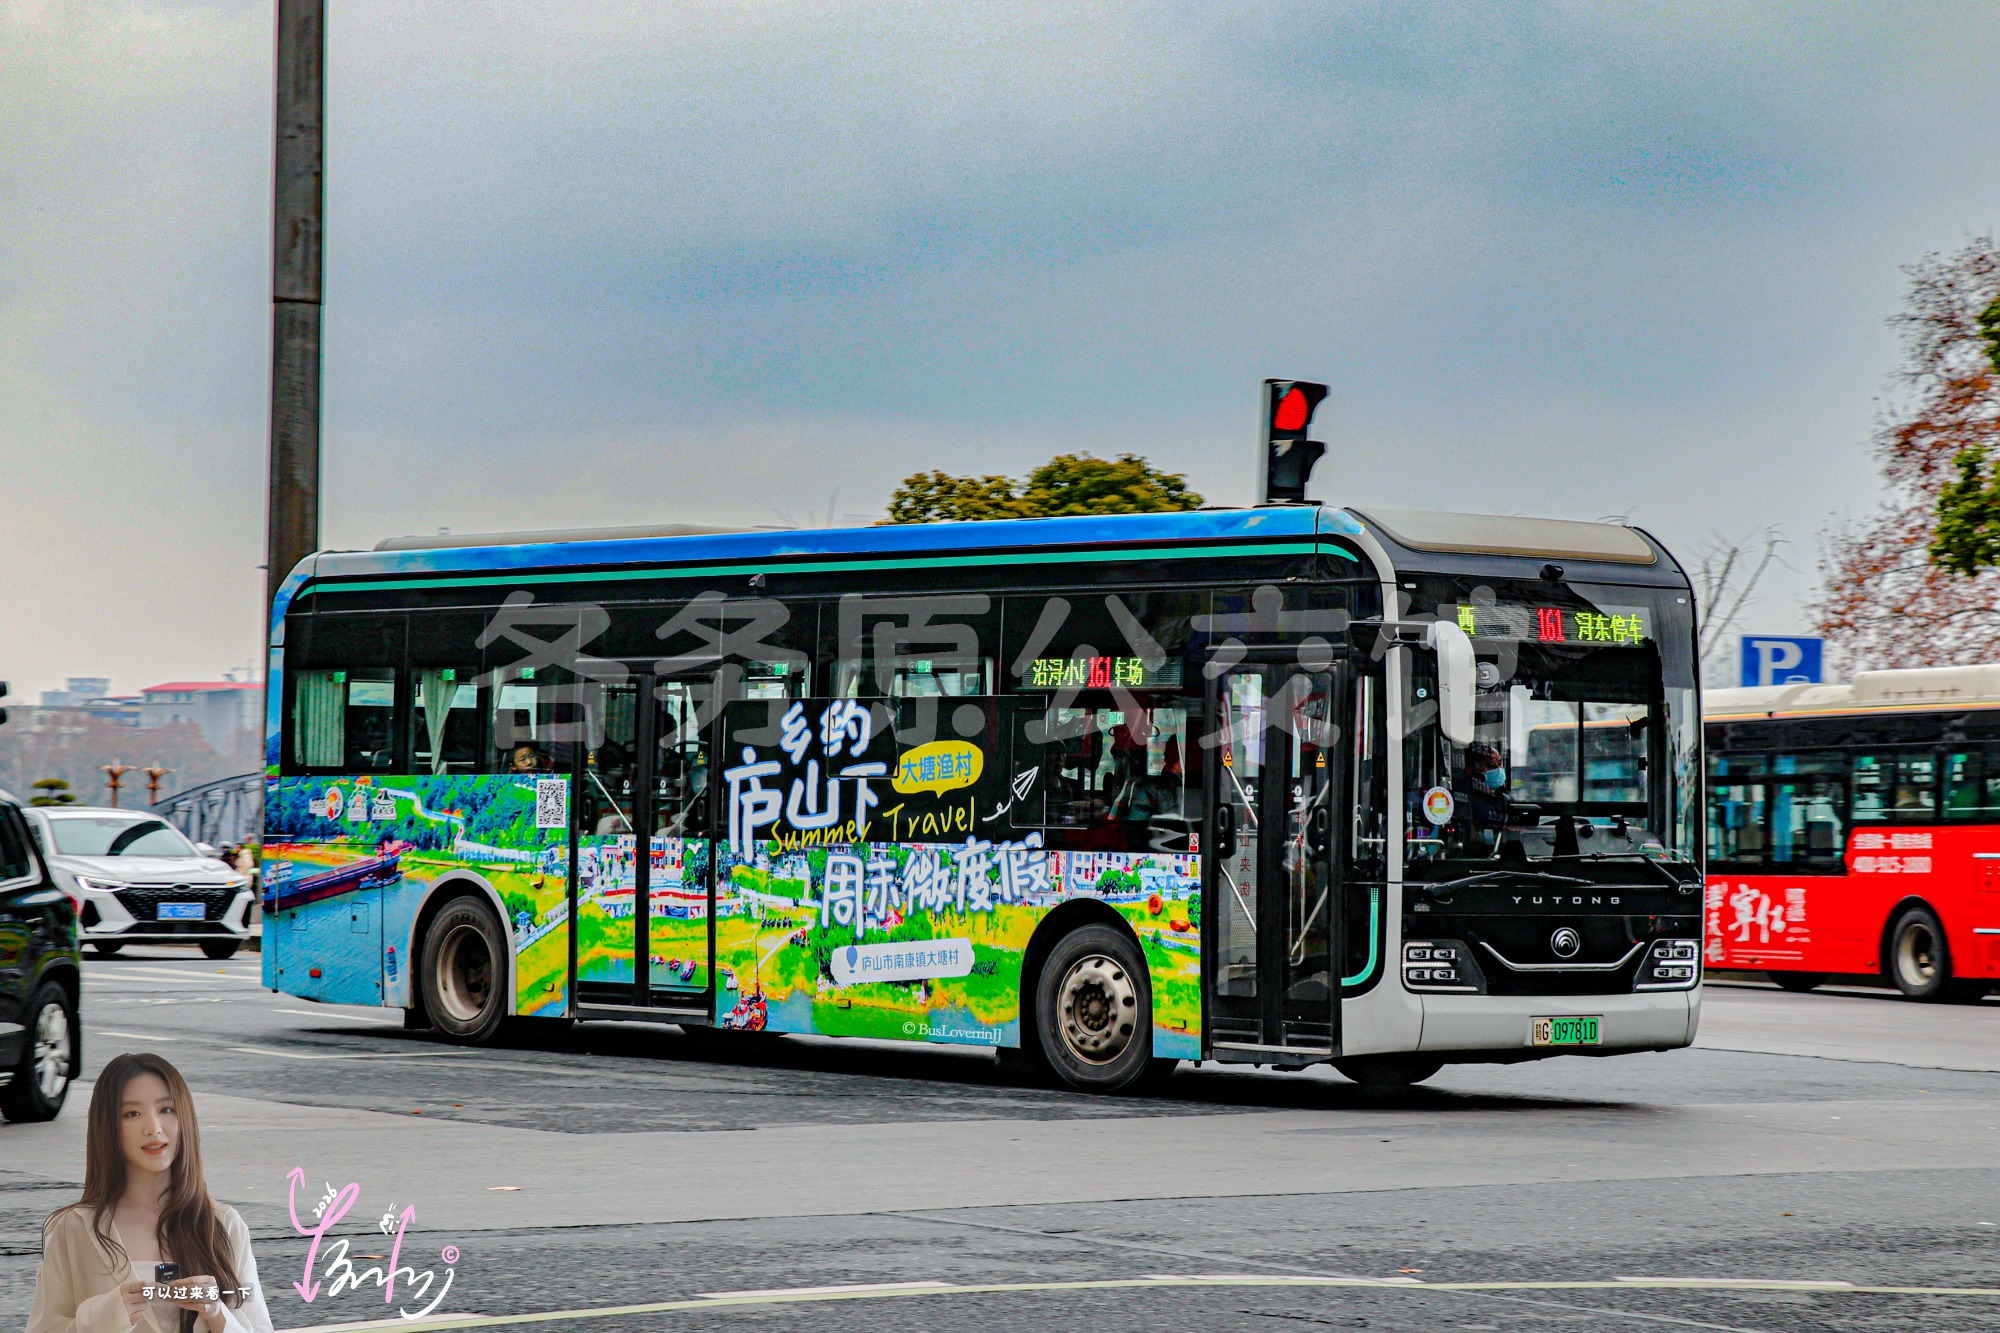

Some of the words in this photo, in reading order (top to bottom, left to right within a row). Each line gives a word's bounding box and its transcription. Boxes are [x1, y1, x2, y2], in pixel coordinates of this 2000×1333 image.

[1537, 607, 1566, 642] 161
[1087, 656, 1112, 688] 161
[1752, 640, 1803, 686] P
[780, 699, 872, 764] 乡约
[901, 750, 972, 784] 大塘渔村
[724, 747, 887, 863] 庐山下
[769, 819, 873, 857] Summer
[882, 796, 975, 842] Travel
[1512, 896, 1620, 904] YUTONG
[861, 948, 959, 972] 庐山市南康镇大塘村
